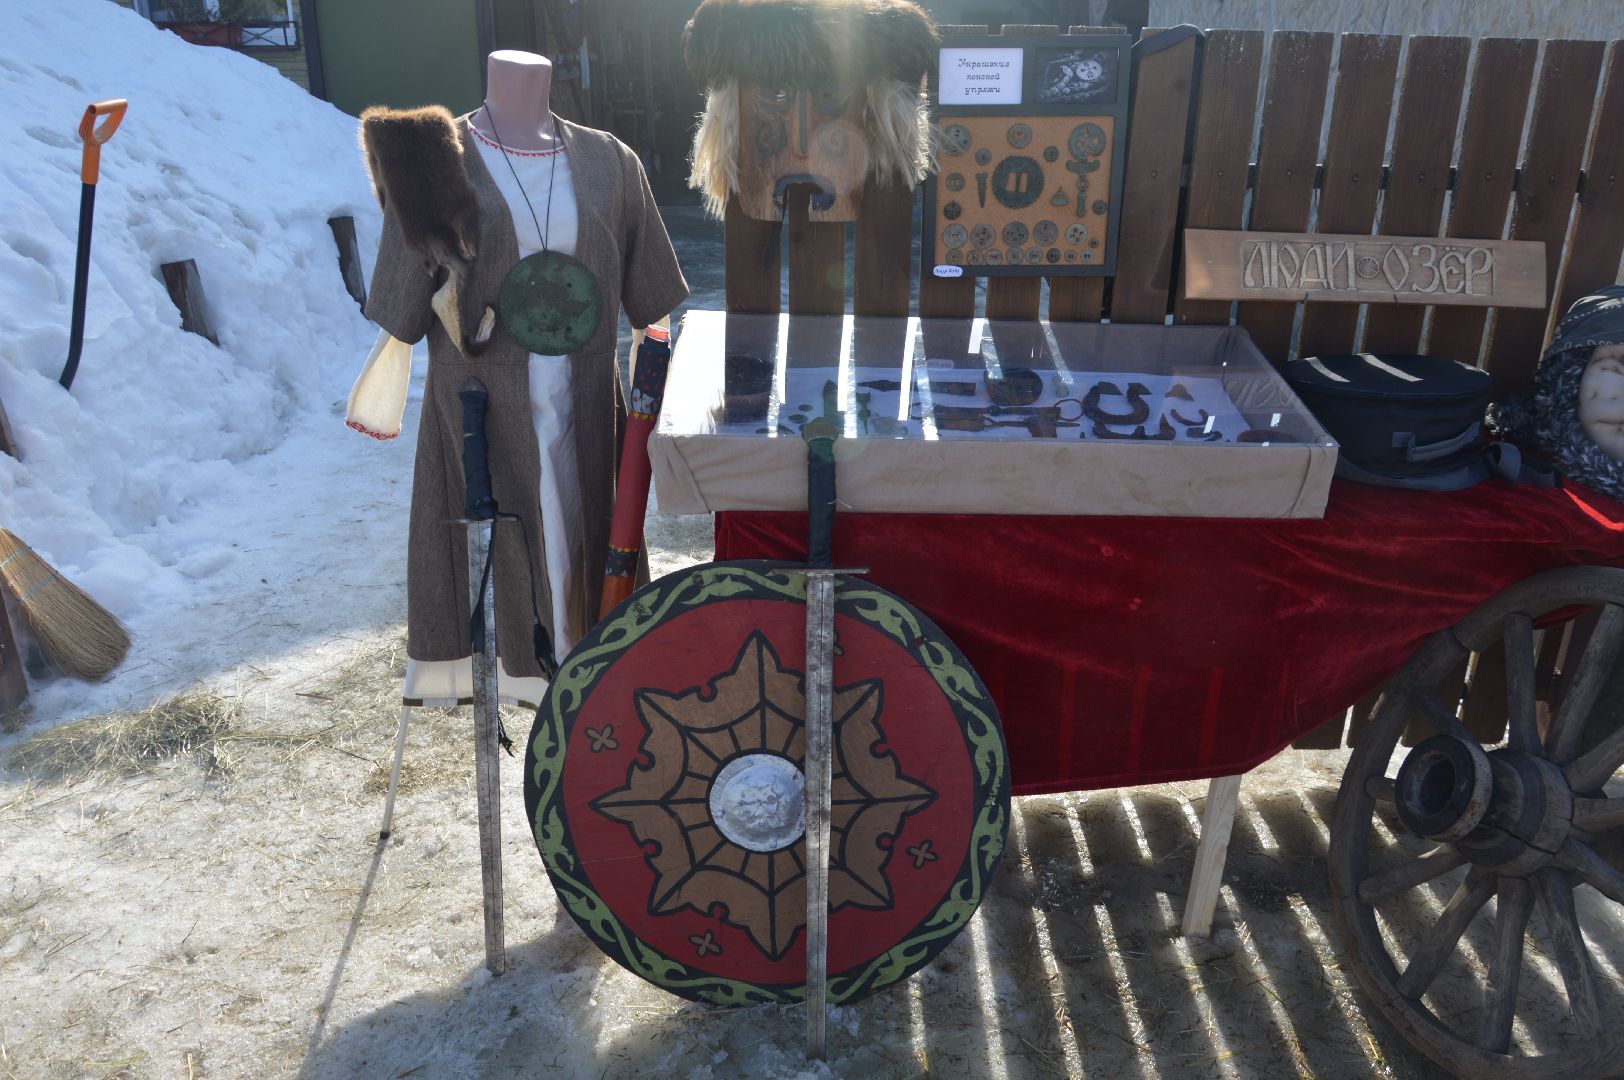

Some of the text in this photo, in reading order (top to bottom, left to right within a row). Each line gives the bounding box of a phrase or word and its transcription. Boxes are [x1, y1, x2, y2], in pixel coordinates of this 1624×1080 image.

[958, 58, 1010, 69] Украшения
[964, 87, 1001, 95] упряжи
[1244, 240, 1494, 295] ЛЮДИ ОЗЁР
